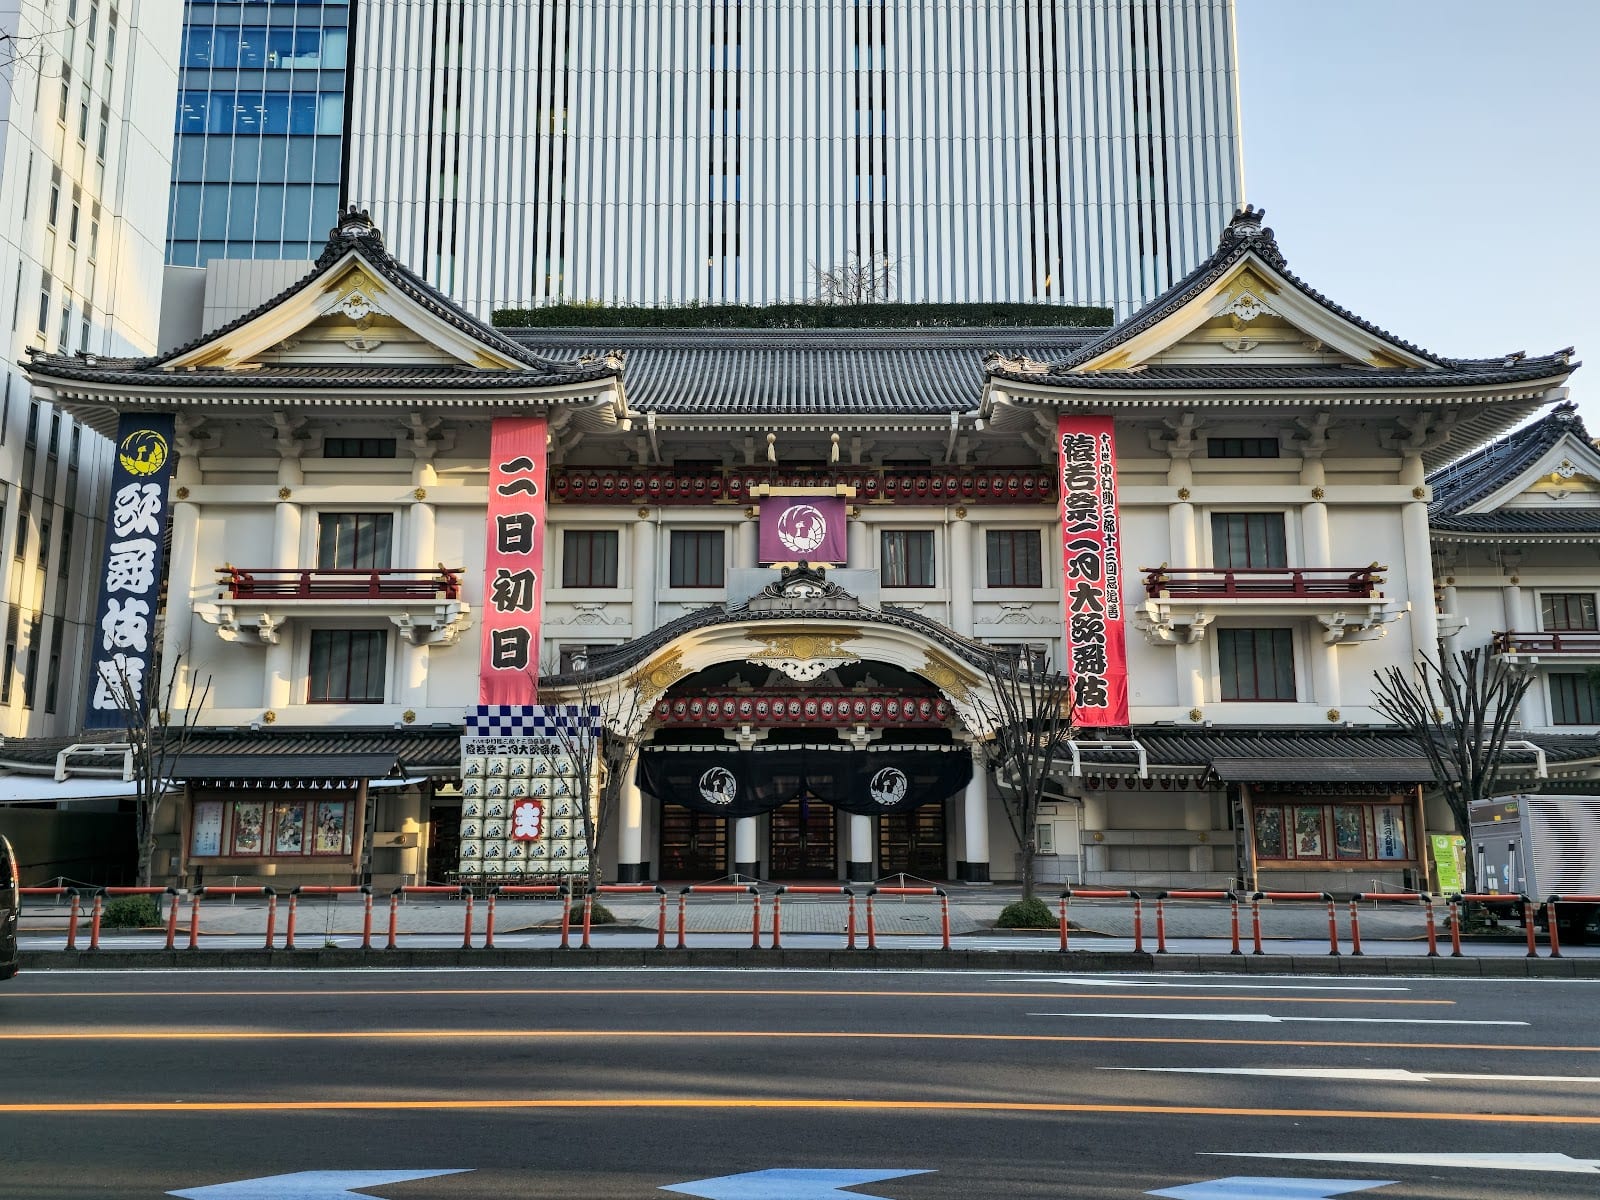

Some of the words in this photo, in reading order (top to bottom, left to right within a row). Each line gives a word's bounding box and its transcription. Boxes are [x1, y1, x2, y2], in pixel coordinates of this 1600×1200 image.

[93, 482, 161, 711] 歌舞伎座
[490, 456, 537, 671] 二日初日
[1062, 432, 1109, 708] 猿若祭二月大歌舞伎
